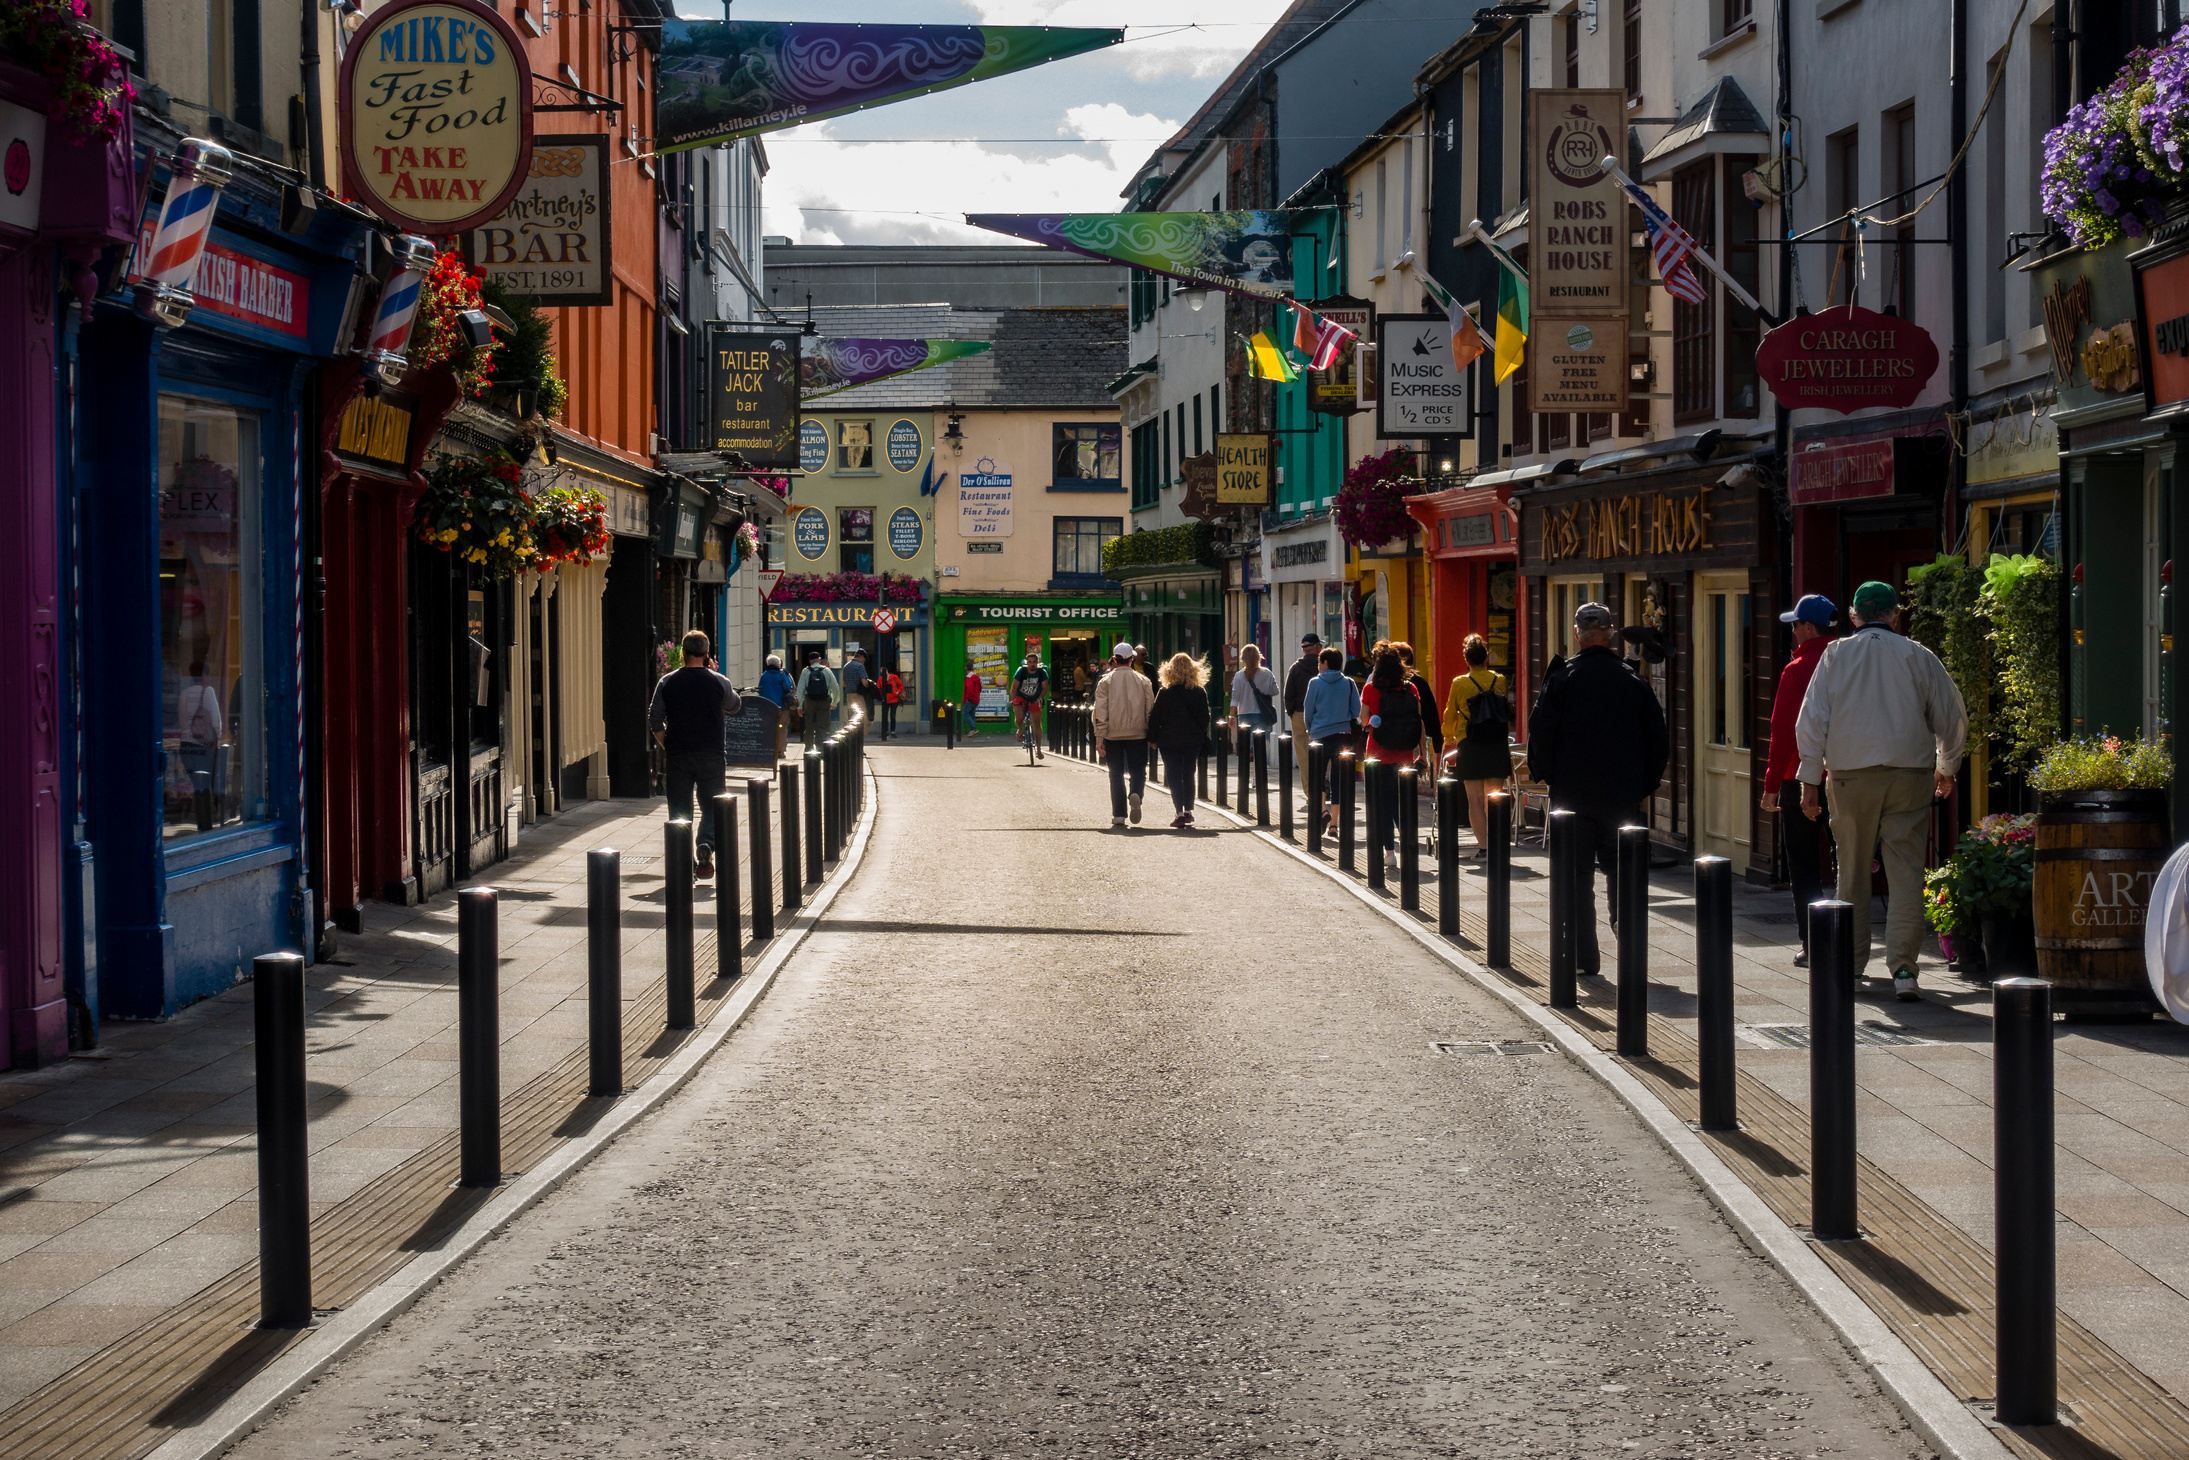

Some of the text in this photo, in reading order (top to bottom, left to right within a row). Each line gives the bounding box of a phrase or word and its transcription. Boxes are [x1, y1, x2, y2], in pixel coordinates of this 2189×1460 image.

[379, 16, 496, 66] MIKE'S
[365, 69, 475, 108] Fast
[385, 97, 507, 141] Food
[672, 104, 807, 144] www.killarney.ie
[1564, 120, 1596, 133] ROBS
[1567, 140, 1593, 158] RRH
[373, 146, 468, 175] TAKE
[389, 171, 487, 201] AWAY
[492, 189, 597, 232] urtney's
[1553, 201, 1607, 221] ROBS
[1547, 226, 1614, 246] RANCH
[479, 229, 592, 265] BAR
[1547, 251, 1613, 271] HOUSE
[193, 250, 237, 306] KISH
[238, 263, 293, 325] BARBER
[494, 271, 586, 288] EST. 1891
[1170, 261, 1286, 299] The Town in The Park
[1549, 286, 1610, 297] RESTAURANT
[1799, 330, 1897, 351] CARAGH
[719, 351, 770, 371] TATLER
[1552, 355, 1606, 365] GLUTEN
[1391, 362, 1444, 378] MUSIC
[1562, 368, 1597, 377] FREE
[1780, 358, 1916, 383] JEWELLERS
[725, 373, 763, 393] JACK
[1391, 381, 1462, 397] EXPRESS
[1560, 380, 1599, 390] MENU
[1799, 384, 1896, 397] IRISH JEWELLERY
[736, 399, 758, 412] bar
[1542, 393, 1617, 402] AVAILABLE
[1400, 405, 1454, 424] 1/2 PRICE
[1424, 416, 1451, 425] CD'S
[722, 419, 770, 430] restaurant
[717, 437, 773, 448] accommodation
[800, 436, 826, 444] ALMON
[890, 434, 918, 442] LOBSTER
[812, 448, 826, 456] Fish
[890, 449, 918, 458] SEA TANK
[1217, 446, 1267, 467] HEALTH
[1191, 463, 1216, 480] Joeva
[1797, 451, 1885, 491] CARAGH JEWELLERS
[962, 476, 1011, 487] Der O'Sullivan
[1222, 470, 1263, 491] STORE
[960, 490, 1012, 500] Restaurant
[962, 507, 1011, 516] Fine Foods
[973, 524, 996, 532] Deli
[1541, 485, 1714, 564] ROBS RANCH HOUSE
[768, 607, 915, 623] RESTAURANT
[979, 607, 1118, 618] TOURIST OFFICE
[2073, 871, 2161, 908] ART
[2072, 909, 2148, 927] GALLE
